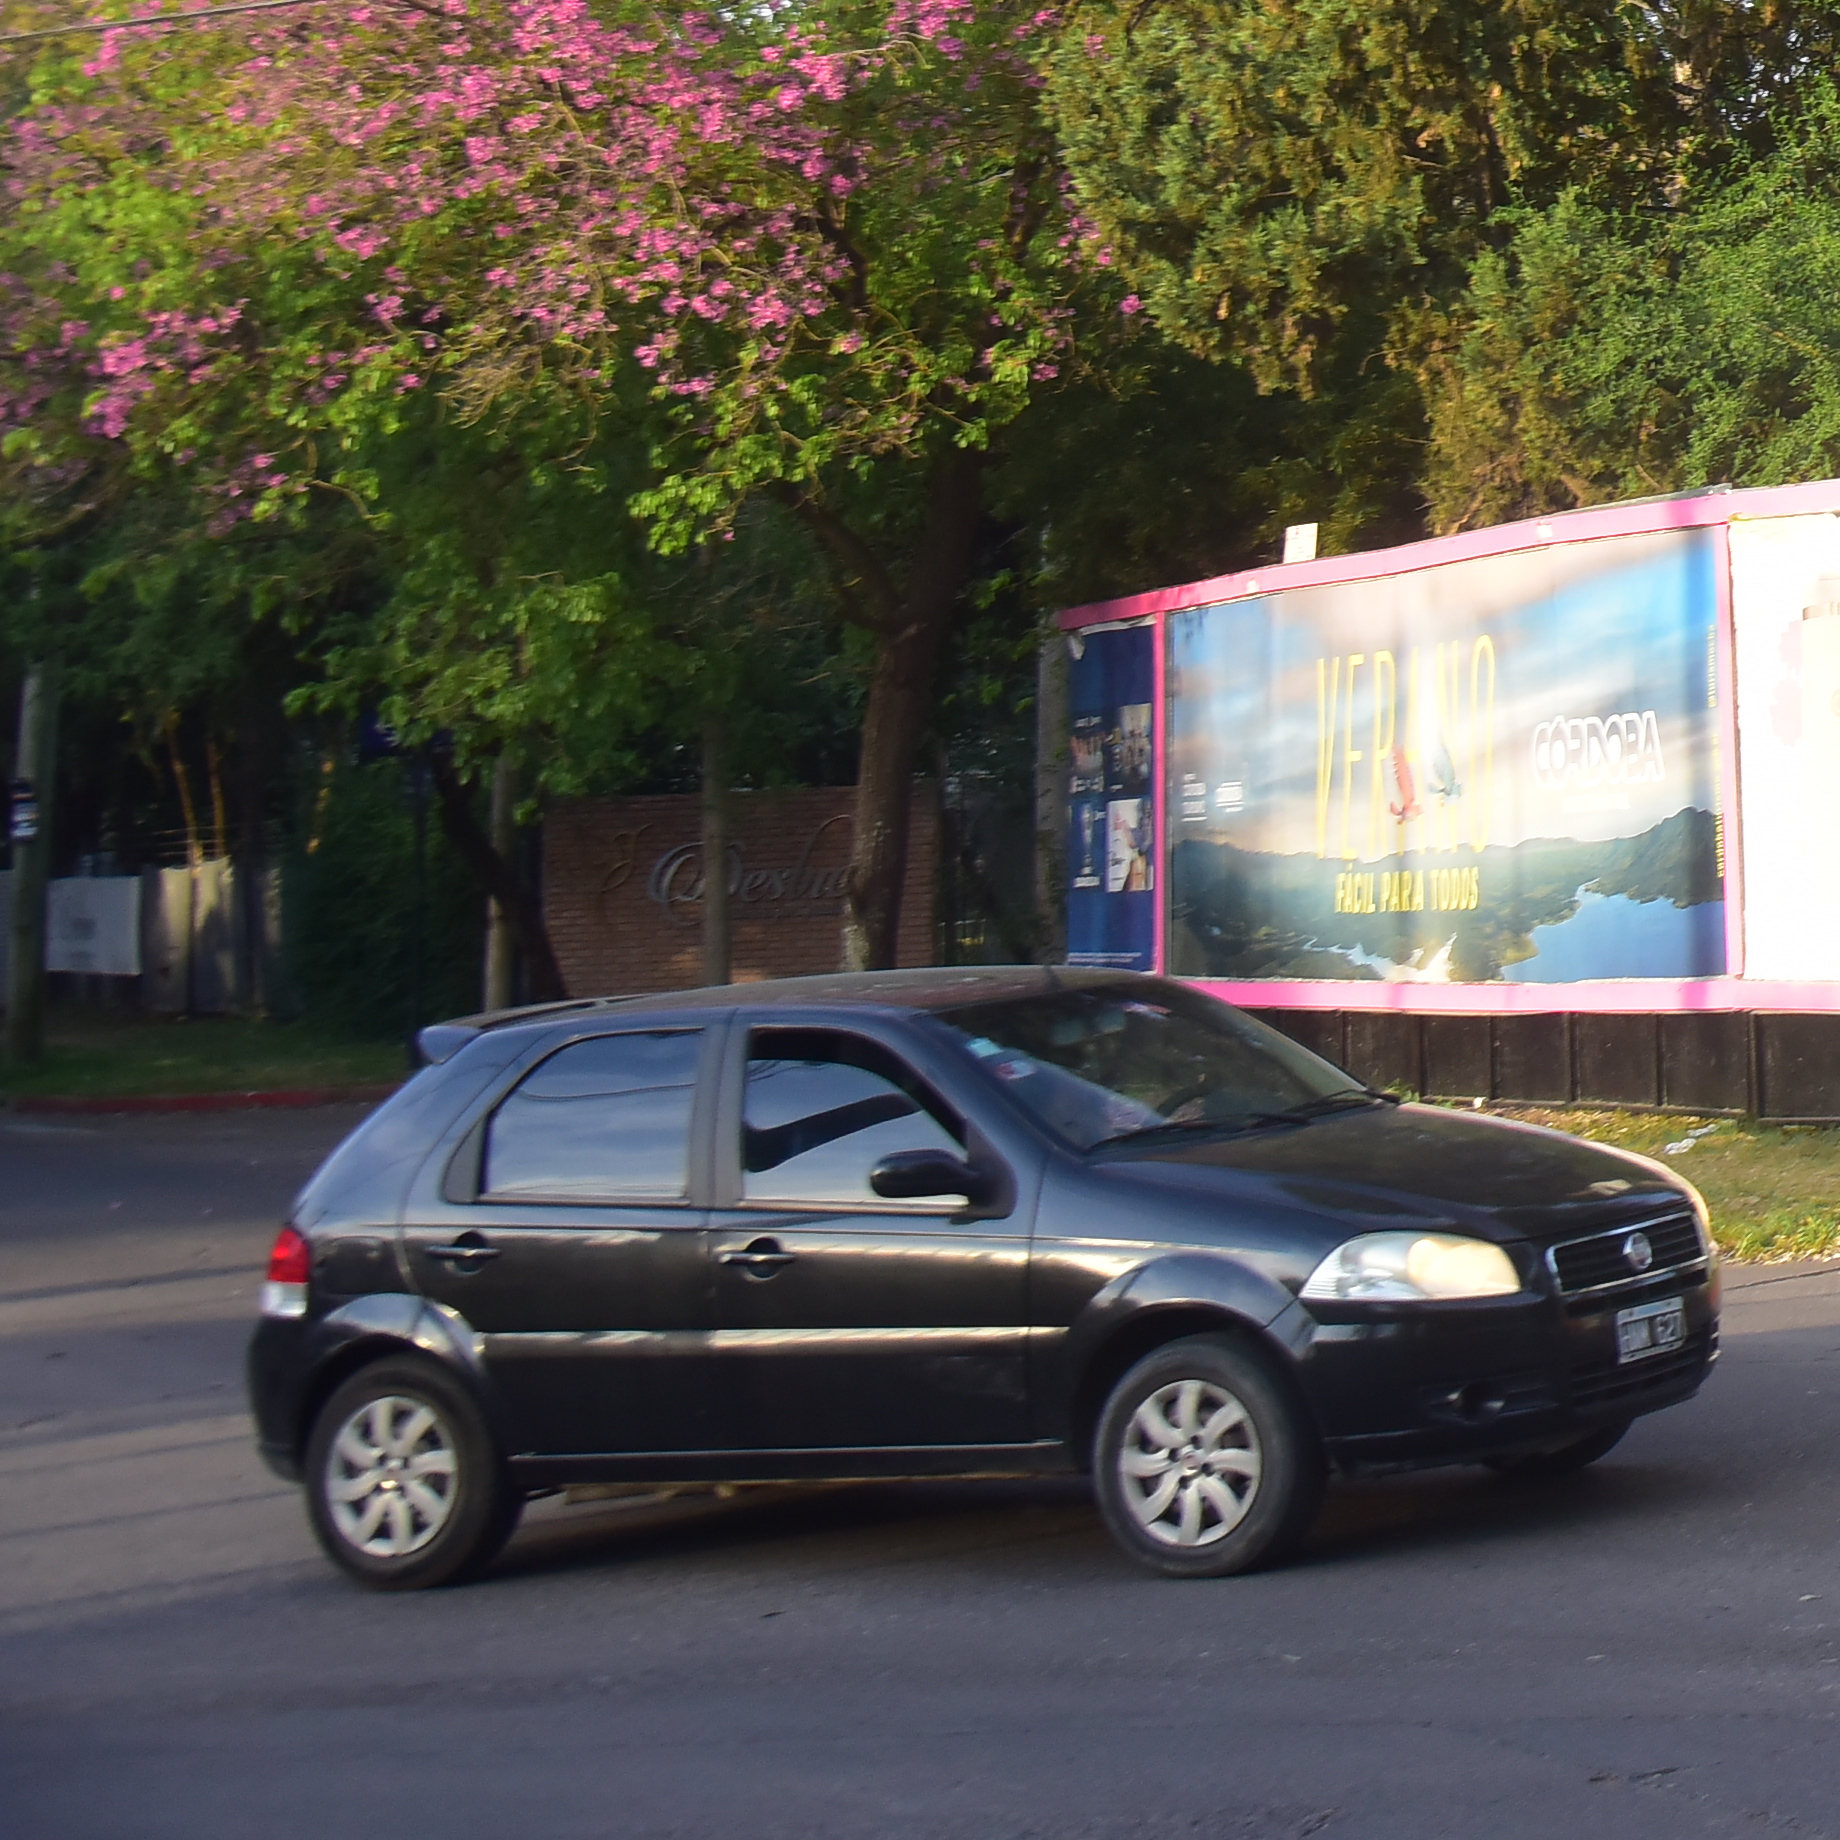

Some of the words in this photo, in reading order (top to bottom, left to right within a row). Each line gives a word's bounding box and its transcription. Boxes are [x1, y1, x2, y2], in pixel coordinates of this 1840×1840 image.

[1316, 634, 1496, 860] VERANO
[1533, 710, 1665, 789] CÓRDOBA
[1334, 863, 1377, 914] FÁCIL
[1379, 869, 1425, 913] PARA
[1429, 866, 1480, 912] TODOS
